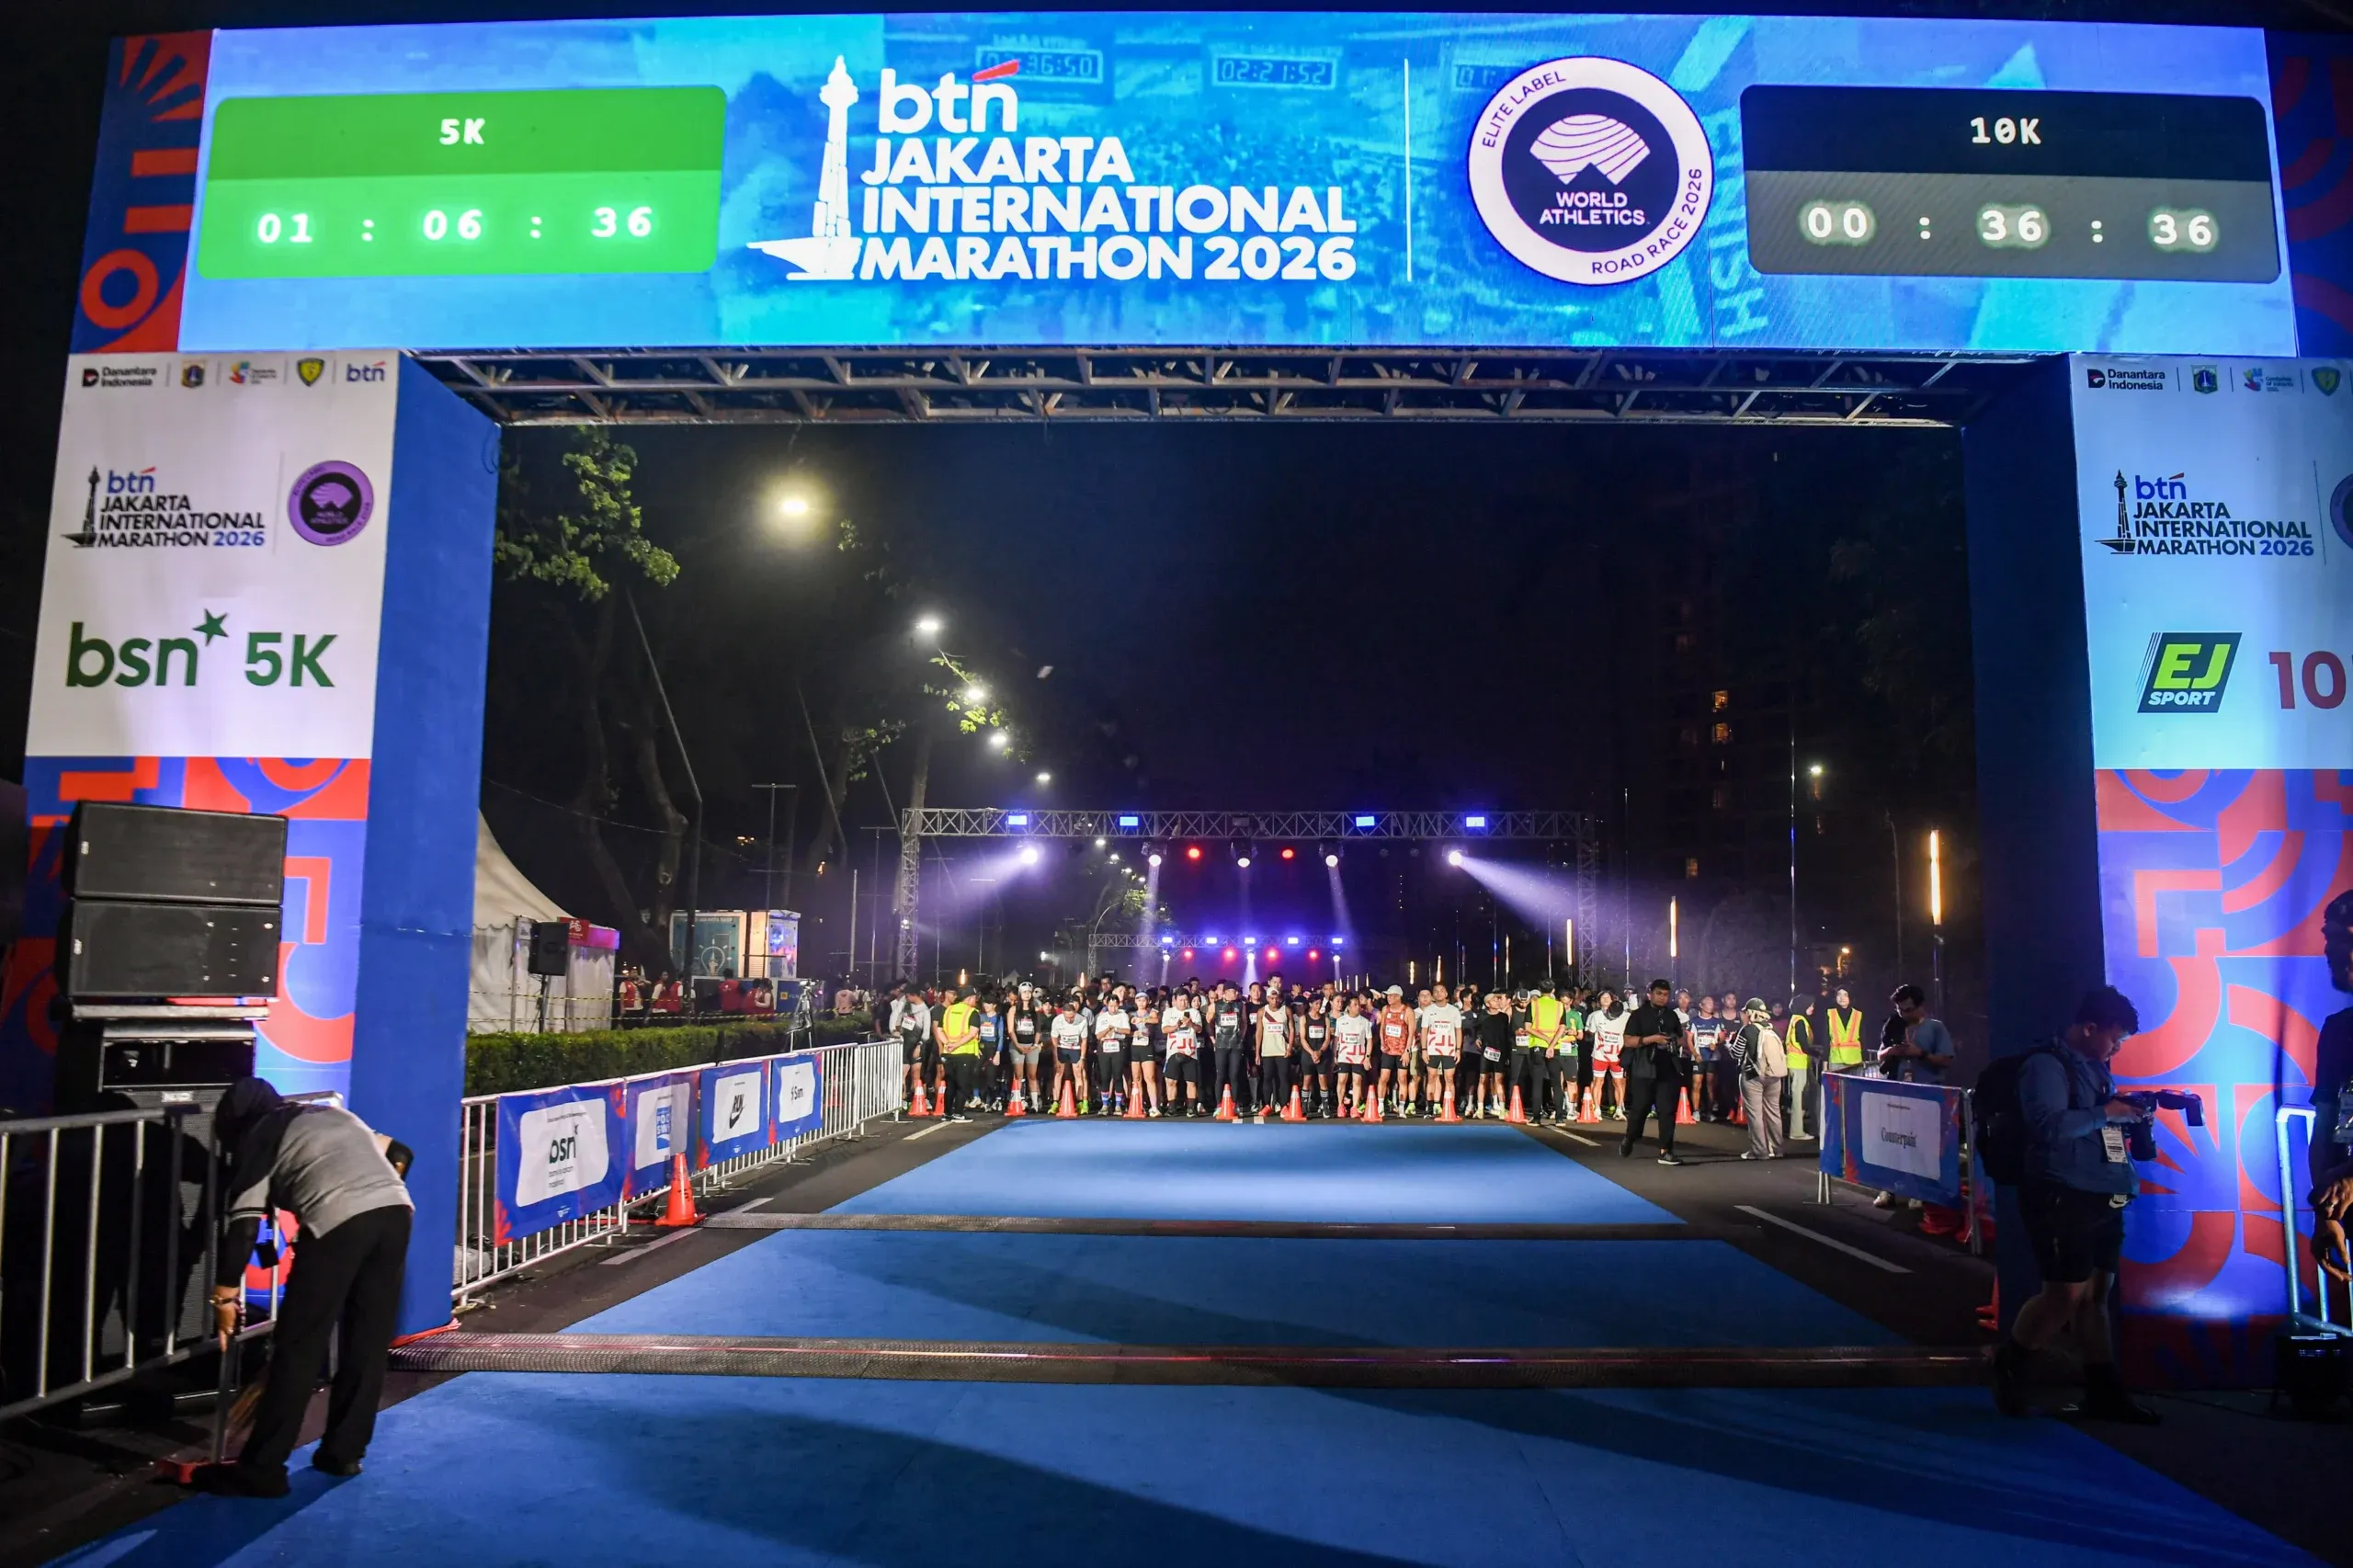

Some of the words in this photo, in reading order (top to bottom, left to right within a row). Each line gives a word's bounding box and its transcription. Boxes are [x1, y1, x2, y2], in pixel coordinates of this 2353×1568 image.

[1483, 103, 1513, 148] ELITE
[1510, 71, 1566, 105] LABEL
[440, 118, 485, 145] 5K
[1971, 117, 2041, 145] 10K
[861, 136, 1135, 185] JAKARTA
[861, 185, 1358, 233] INTERNATIONAL
[1555, 191, 1628, 208] WORLD
[257, 212, 313, 244] 01
[423, 209, 483, 241] 06
[591, 206, 654, 238] 36
[1539, 209, 1645, 226] ATHLETICS
[1591, 252, 1644, 275] ROAD
[1647, 217, 1688, 258] RACE
[1681, 168, 1703, 216] 2026
[1807, 207, 1869, 239] 00
[1981, 209, 2042, 243] 36
[2153, 214, 2212, 246] 36
[860, 235, 1193, 280] MARATHON
[1204, 235, 1357, 281] 2026
[101, 377, 153, 387] Indonesia
[346, 361, 386, 382] btn
[2108, 369, 2165, 380] Danantara
[2109, 380, 2164, 390] Indonesia
[107, 468, 156, 494] btn
[2134, 472, 2188, 500] btn
[100, 494, 191, 513] JAKARTA
[2132, 502, 2232, 519] JAKARTA
[99, 513, 267, 530] INTERNATIONAL
[2134, 520, 2313, 539] INTERNATIONAL
[97, 531, 210, 548] MARATHON
[212, 530, 266, 547] 2026
[2137, 539, 2256, 556] MARATHON
[2258, 540, 2315, 557] 2026
[64, 621, 199, 687] bsn
[244, 631, 338, 687] 5K
[2153, 643, 2232, 689] EJ
[2268, 650, 2353, 710] 10
[2148, 691, 2217, 706] SPORT
